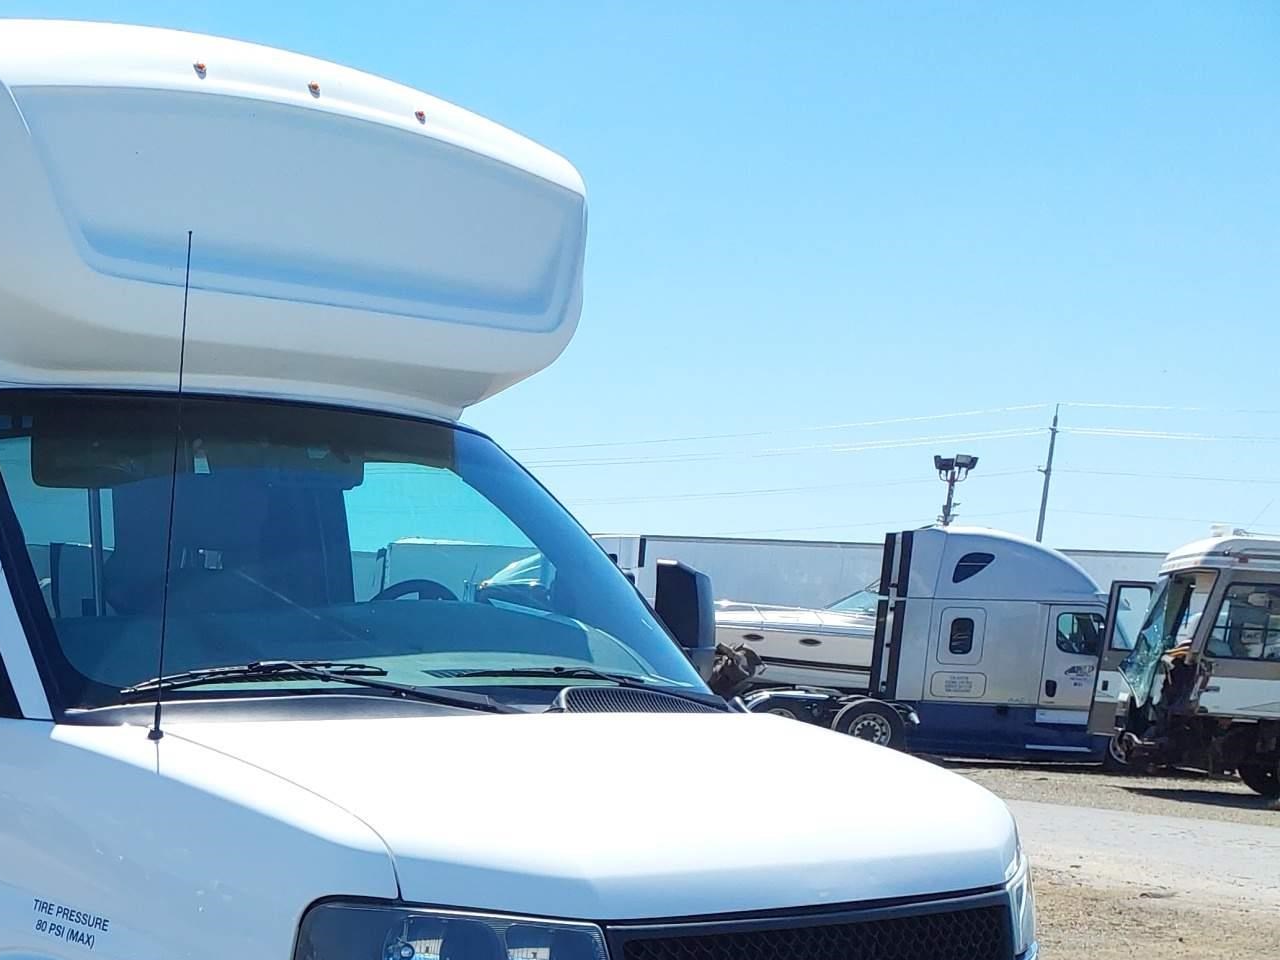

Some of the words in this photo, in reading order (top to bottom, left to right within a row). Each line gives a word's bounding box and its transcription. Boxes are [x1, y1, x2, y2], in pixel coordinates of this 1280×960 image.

[33, 899, 55, 915] TIRE
[55, 906, 110, 932] PRESSURE
[35, 919, 47, 932] 80
[48, 922, 65, 938] PSI
[66, 928, 95, 950] (MAX)
